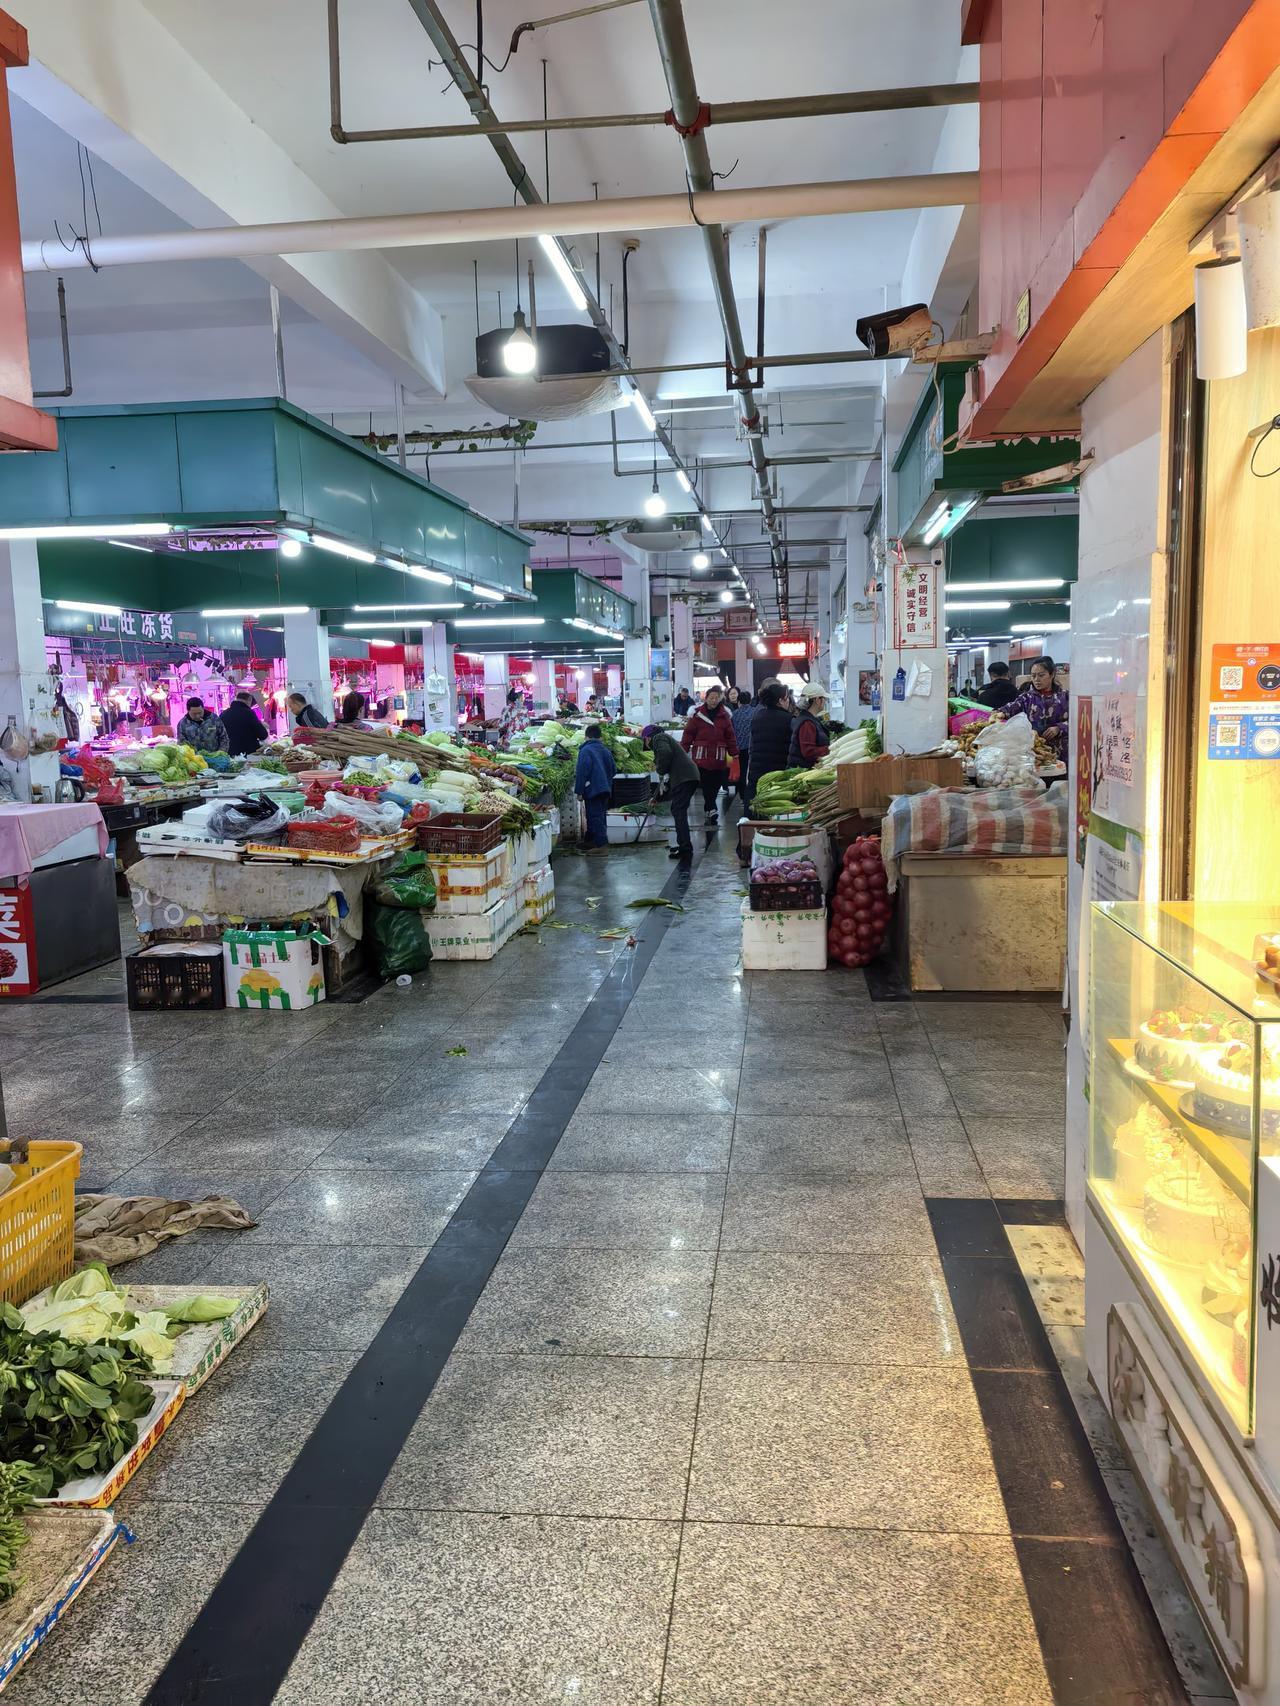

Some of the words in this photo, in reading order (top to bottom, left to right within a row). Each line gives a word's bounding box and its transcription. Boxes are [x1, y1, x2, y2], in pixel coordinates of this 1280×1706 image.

[906, 588, 916, 633] 诚实守信
[918, 572, 928, 618] 文明经营
